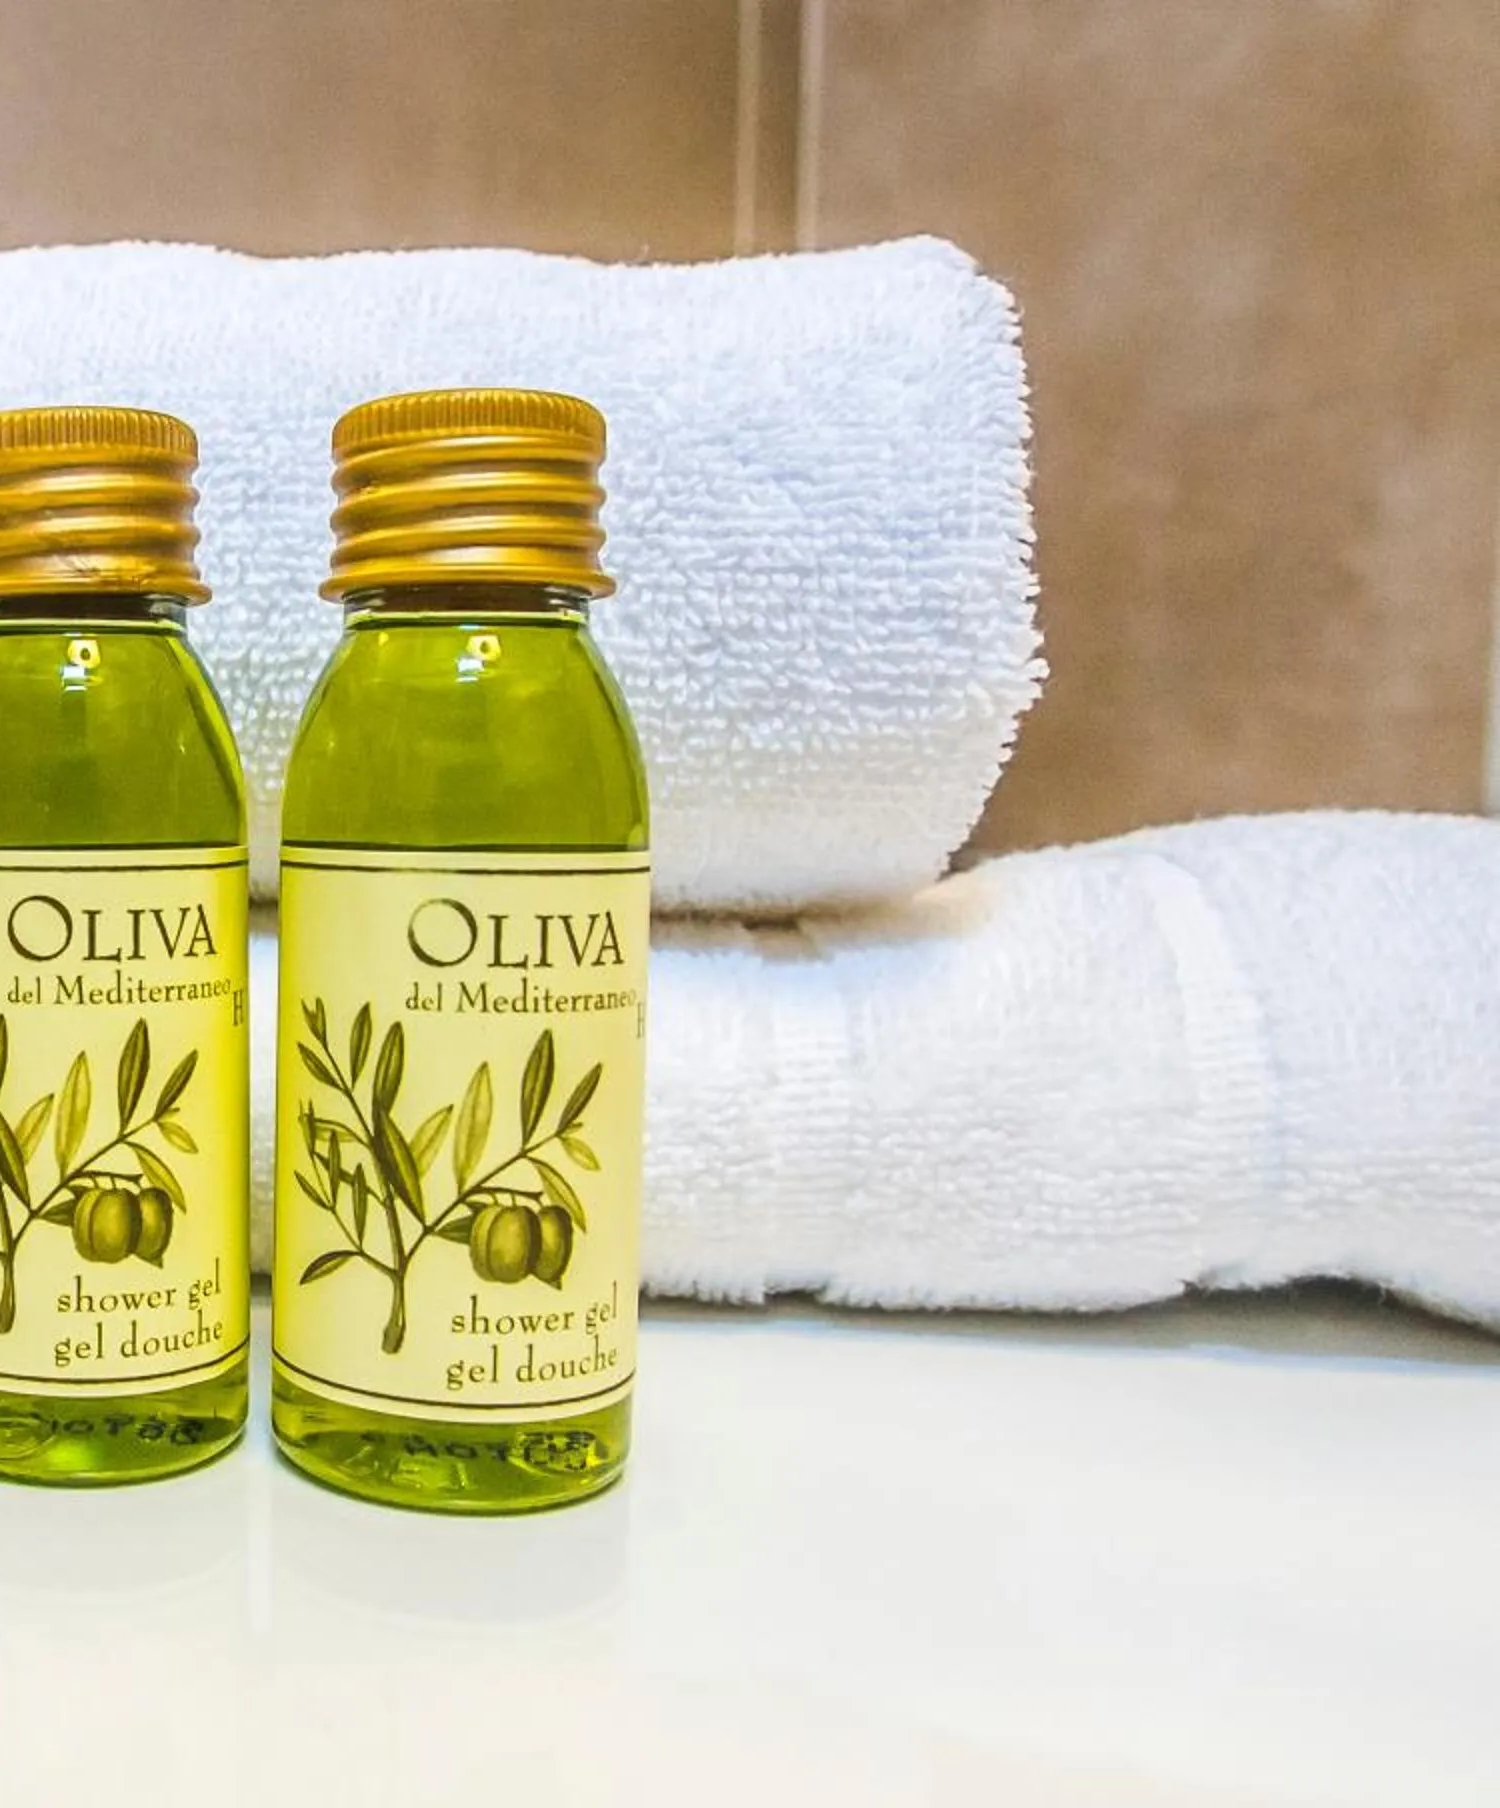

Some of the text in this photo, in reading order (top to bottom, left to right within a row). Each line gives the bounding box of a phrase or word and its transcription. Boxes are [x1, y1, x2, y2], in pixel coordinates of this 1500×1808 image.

[6, 894, 218, 962] OLIVA
[406, 897, 625, 969] OLIVA
[7, 968, 231, 1006] del Mediterraneo
[405, 976, 637, 1014] del Mediterraneo
[57, 1256, 221, 1313] shower gel
[451, 1280, 617, 1335] shower gel
[53, 1308, 224, 1368] gel douche
[446, 1332, 618, 1391] gel douche
